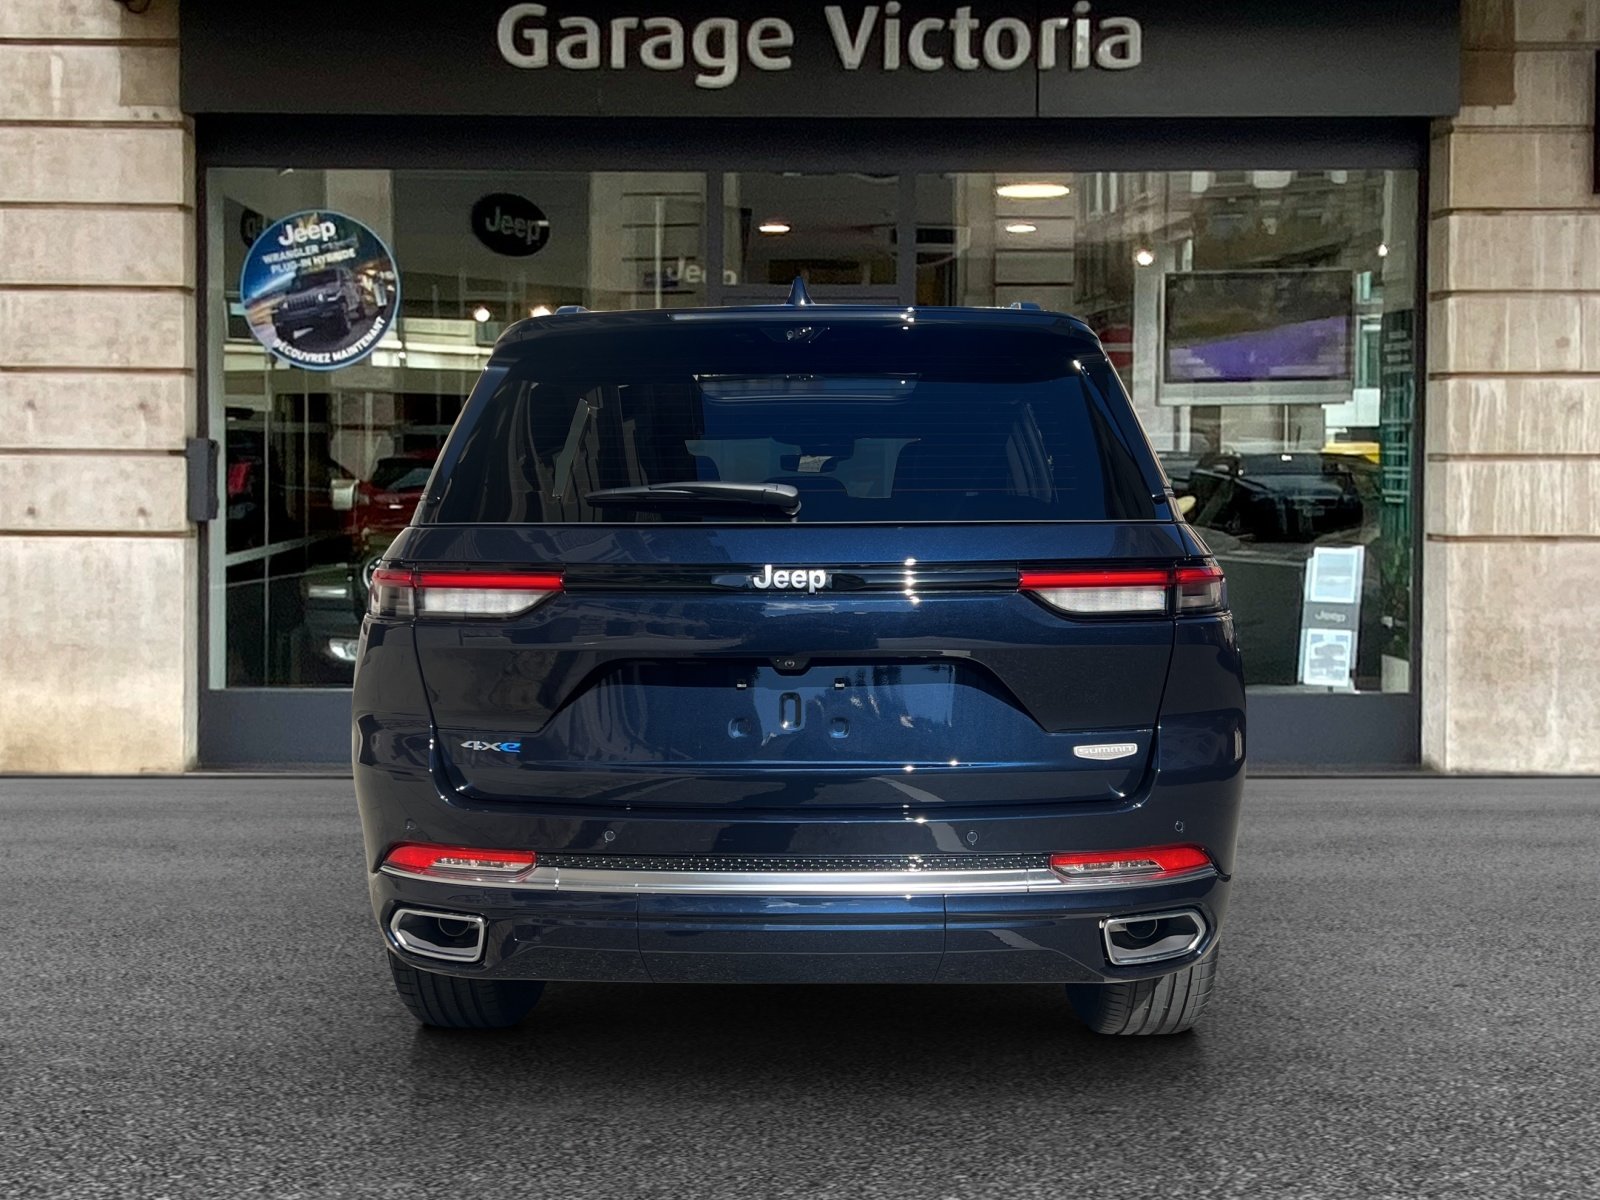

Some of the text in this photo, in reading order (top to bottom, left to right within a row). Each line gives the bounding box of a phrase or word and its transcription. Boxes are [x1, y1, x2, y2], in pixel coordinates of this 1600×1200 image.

[497, 1, 1142, 89] Garage Victoria
[278, 221, 336, 246] Jeep
[485, 206, 541, 245] Jeep
[262, 245, 320, 264] WRANGLER
[665, 258, 737, 285] Jep
[753, 564, 826, 593] Jeep
[1314, 610, 1347, 623] Jeep
